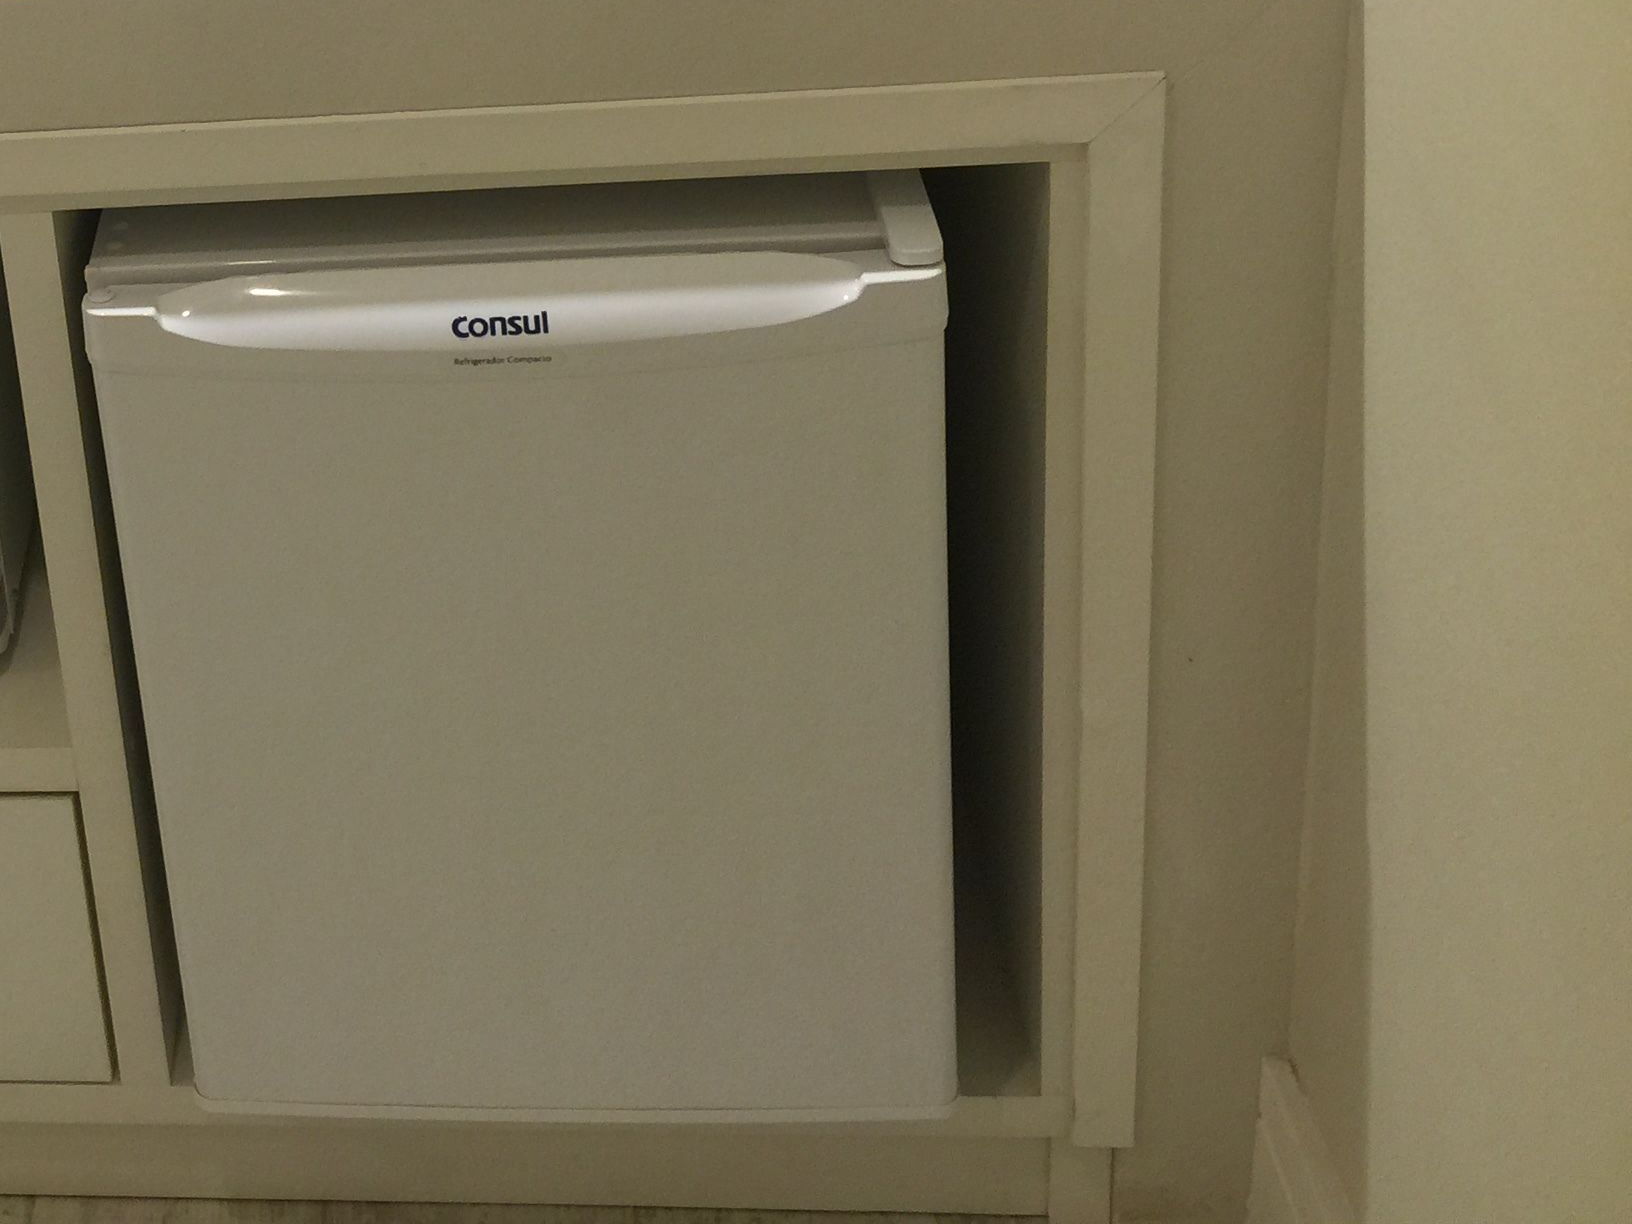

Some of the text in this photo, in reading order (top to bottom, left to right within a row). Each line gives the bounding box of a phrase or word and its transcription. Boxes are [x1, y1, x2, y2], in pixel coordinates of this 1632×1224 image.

[451, 310, 550, 338] consul
[454, 355, 552, 366] Refrigerador Compacto
